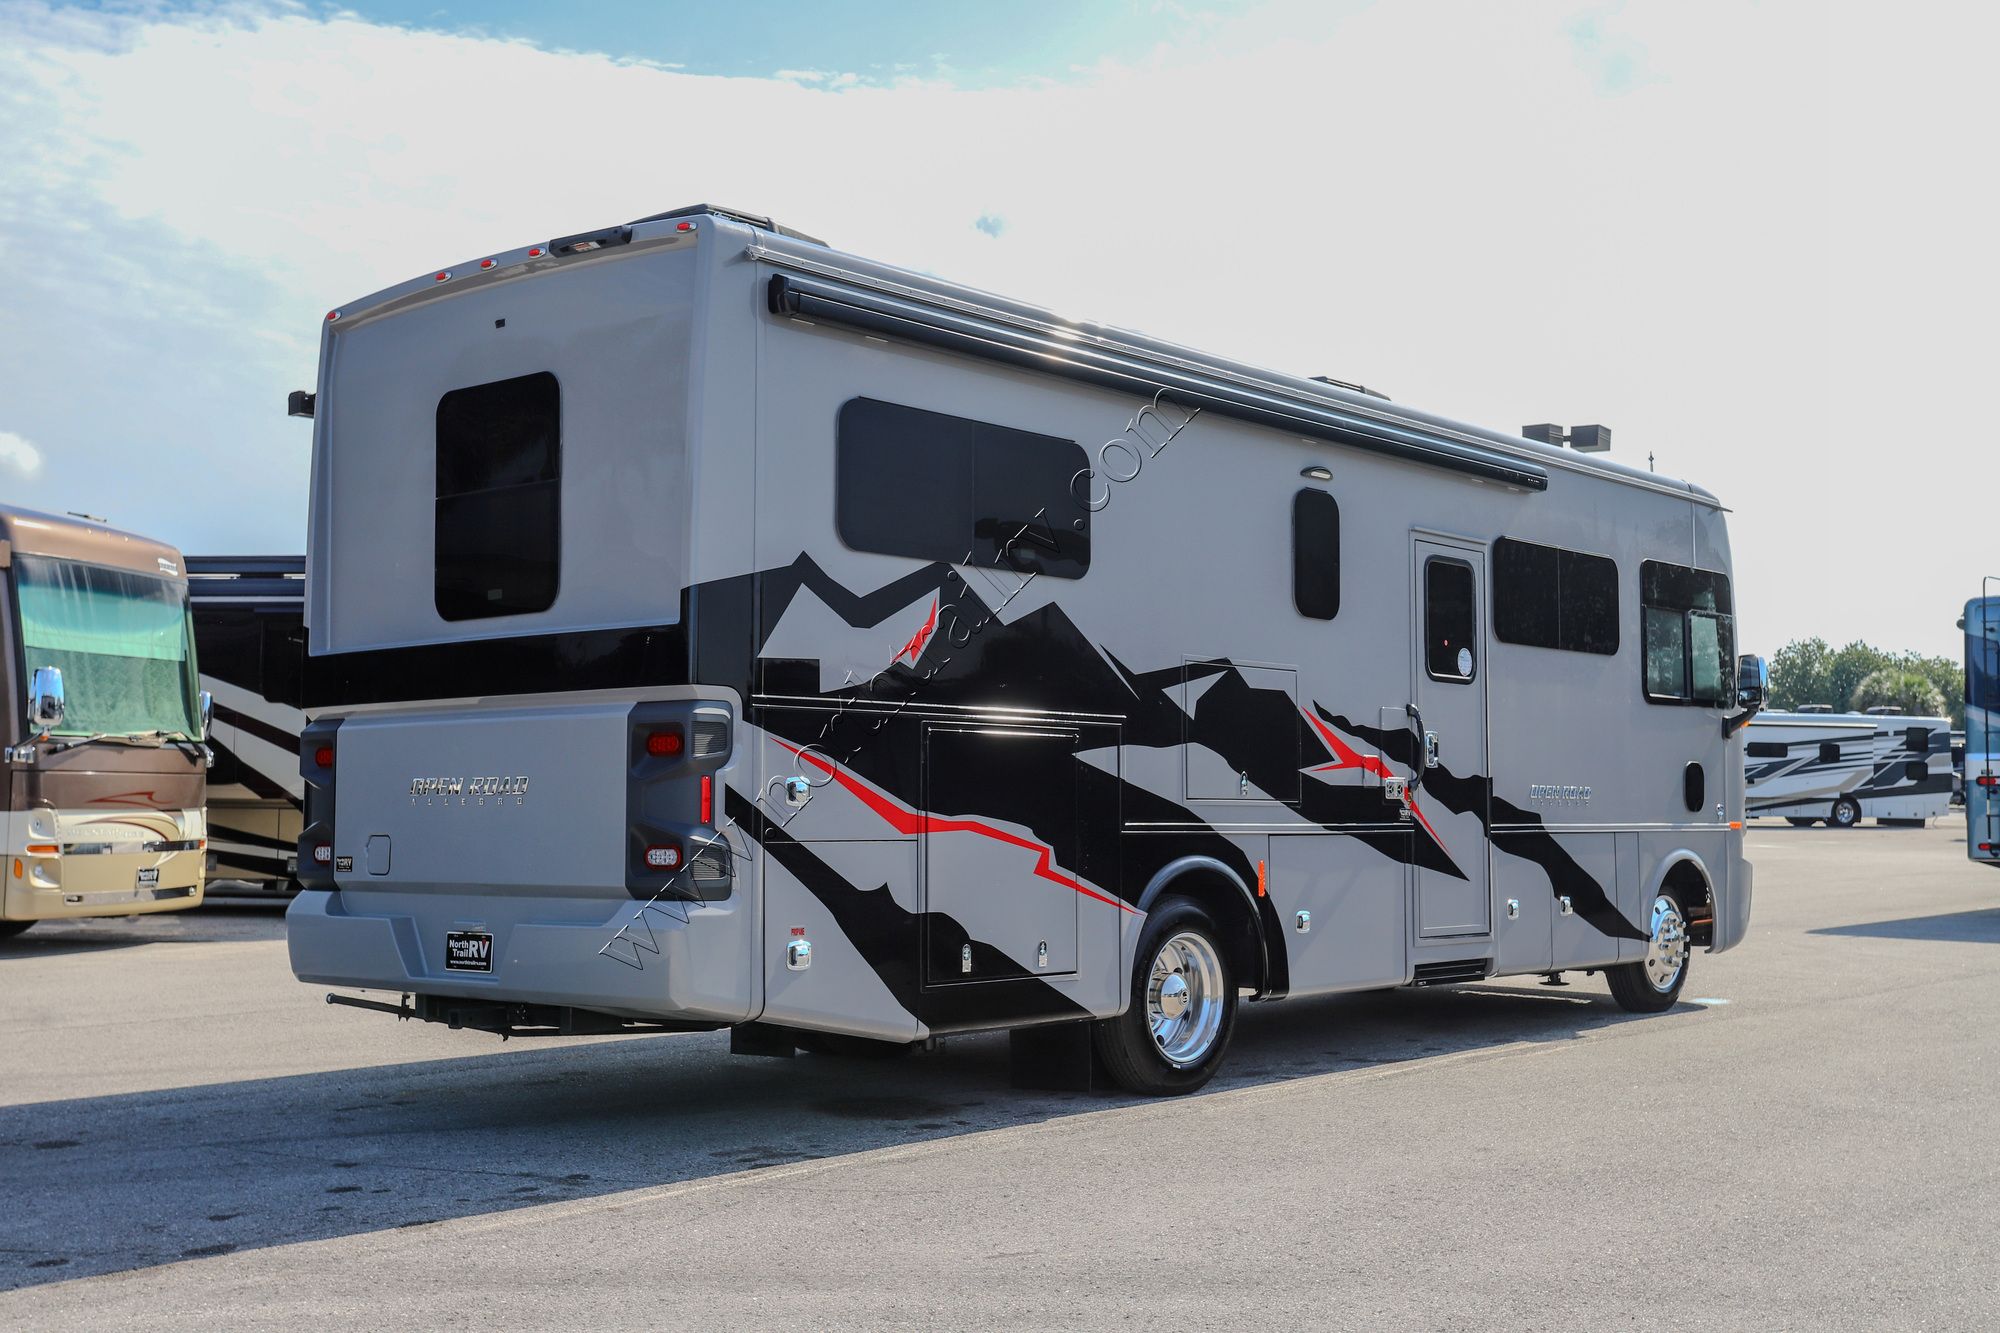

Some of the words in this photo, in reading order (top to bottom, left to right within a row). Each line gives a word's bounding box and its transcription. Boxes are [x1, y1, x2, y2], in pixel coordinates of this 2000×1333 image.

[410, 777, 464, 796] OPEN
[469, 776, 529, 795] ROAD
[1530, 784, 1560, 799] OPEN
[1562, 785, 1592, 800] ROAD
[411, 797, 523, 806] ALLEGRO
[449, 939, 469, 949] North
[469, 940, 490, 959] RV
[452, 948, 469, 958] Trail
